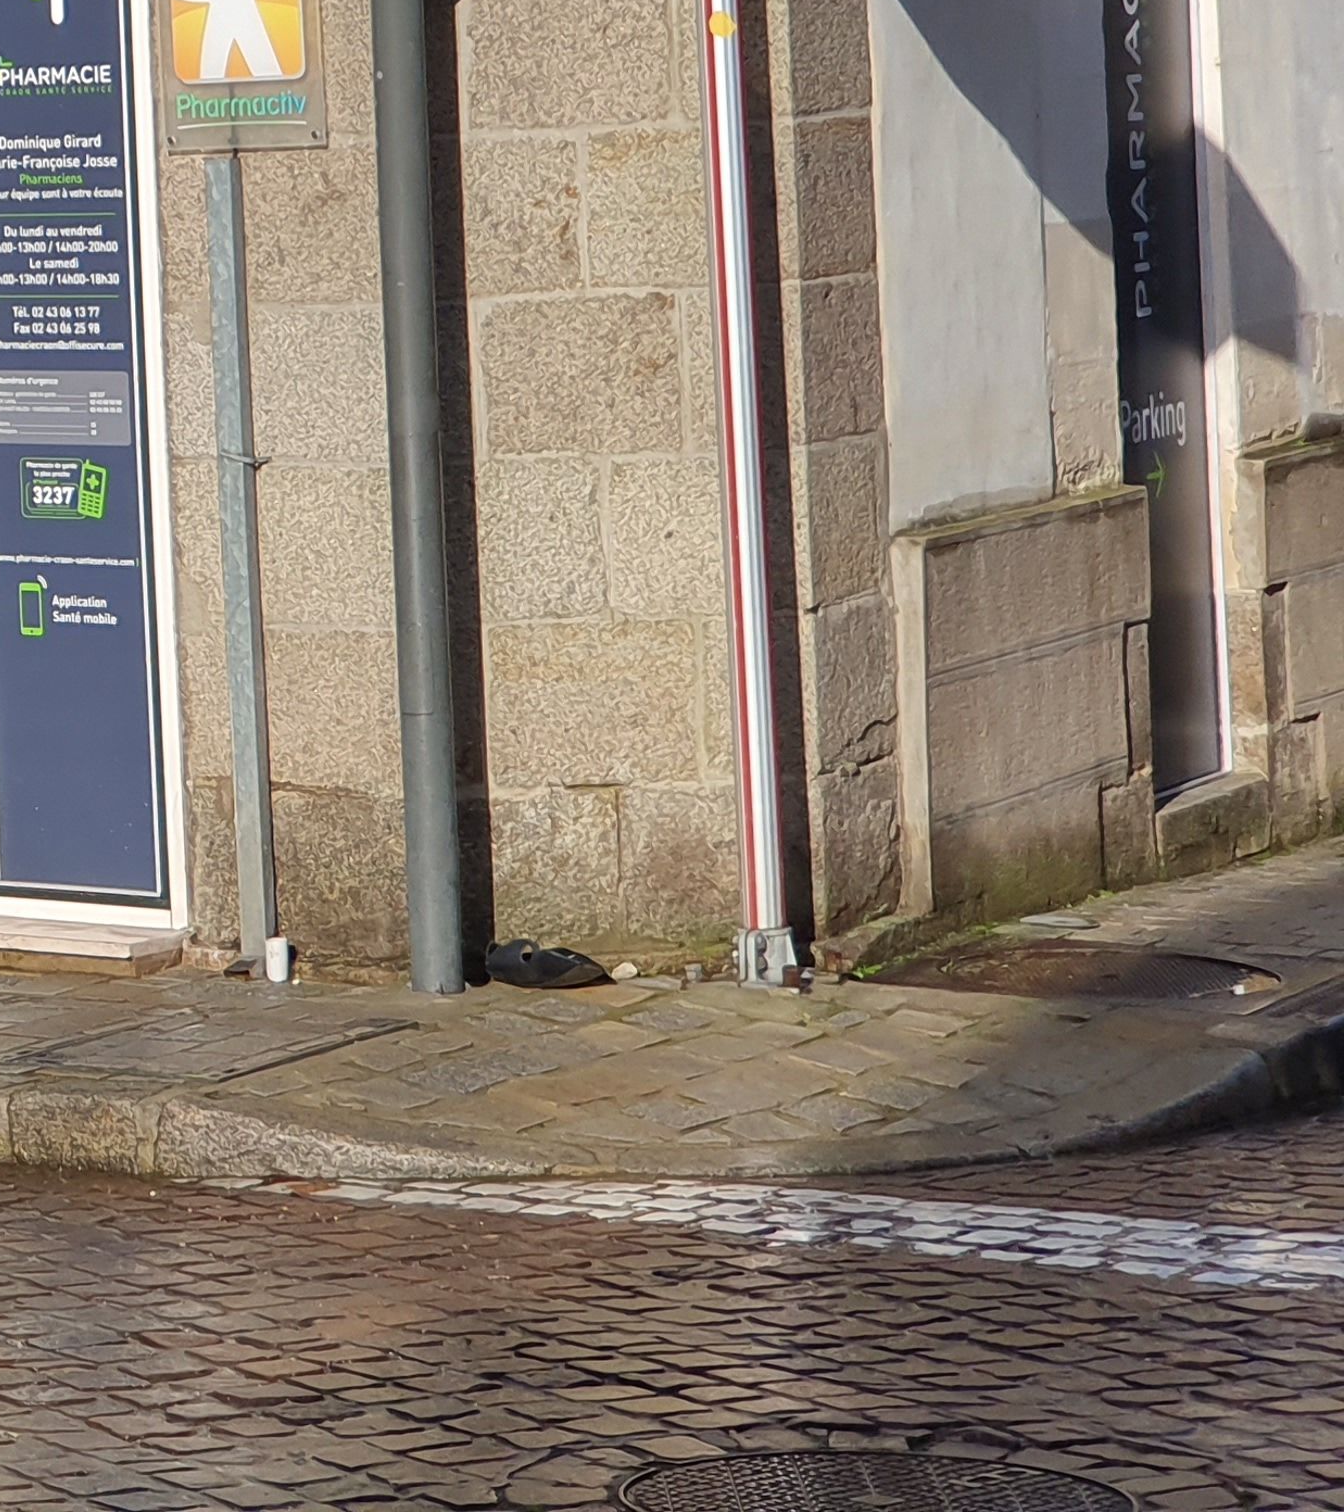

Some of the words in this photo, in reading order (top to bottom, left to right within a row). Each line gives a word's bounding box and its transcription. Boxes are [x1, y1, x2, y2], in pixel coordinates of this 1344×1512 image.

[0, 64, 112, 86] PHARMACIE
[176, 92, 306, 120] Pharmactiv
[64, 134, 101, 148] Girard
[83, 154, 117, 168] Josse
[20, 173, 83, 185] Pharmaciens
[11, 188, 40, 201] équipe
[42, 190, 60, 199] sont
[62, 188, 67, 198] à
[69, 189, 91, 198] votre
[93, 187, 123, 198] écoute
[4, 226, 17, 237] Du
[19, 225, 43, 237] lundi
[46, 227, 58, 236] au
[60, 224, 102, 236] vendredi
[29, 258, 41, 268] Le
[43, 257, 79, 268] samedi
[32, 307, 44, 317] 02
[46, 307, 58, 317] 43
[60, 307, 71, 317] 06
[74, 307, 85, 317] 13
[87, 306, 100, 317] 77
[14, 322, 30, 334] Fax
[32, 323, 44, 334] 02
[46, 323, 58, 334] 43
[60, 322, 71, 334] 06
[74, 323, 86, 334] 25
[88, 322, 100, 334] 98
[1120, 391, 1186, 446] Parking
[33, 486, 75, 504] 3237
[52, 595, 108, 609] Application
[53, 611, 81, 622] Santé
[84, 612, 117, 625] mobile
